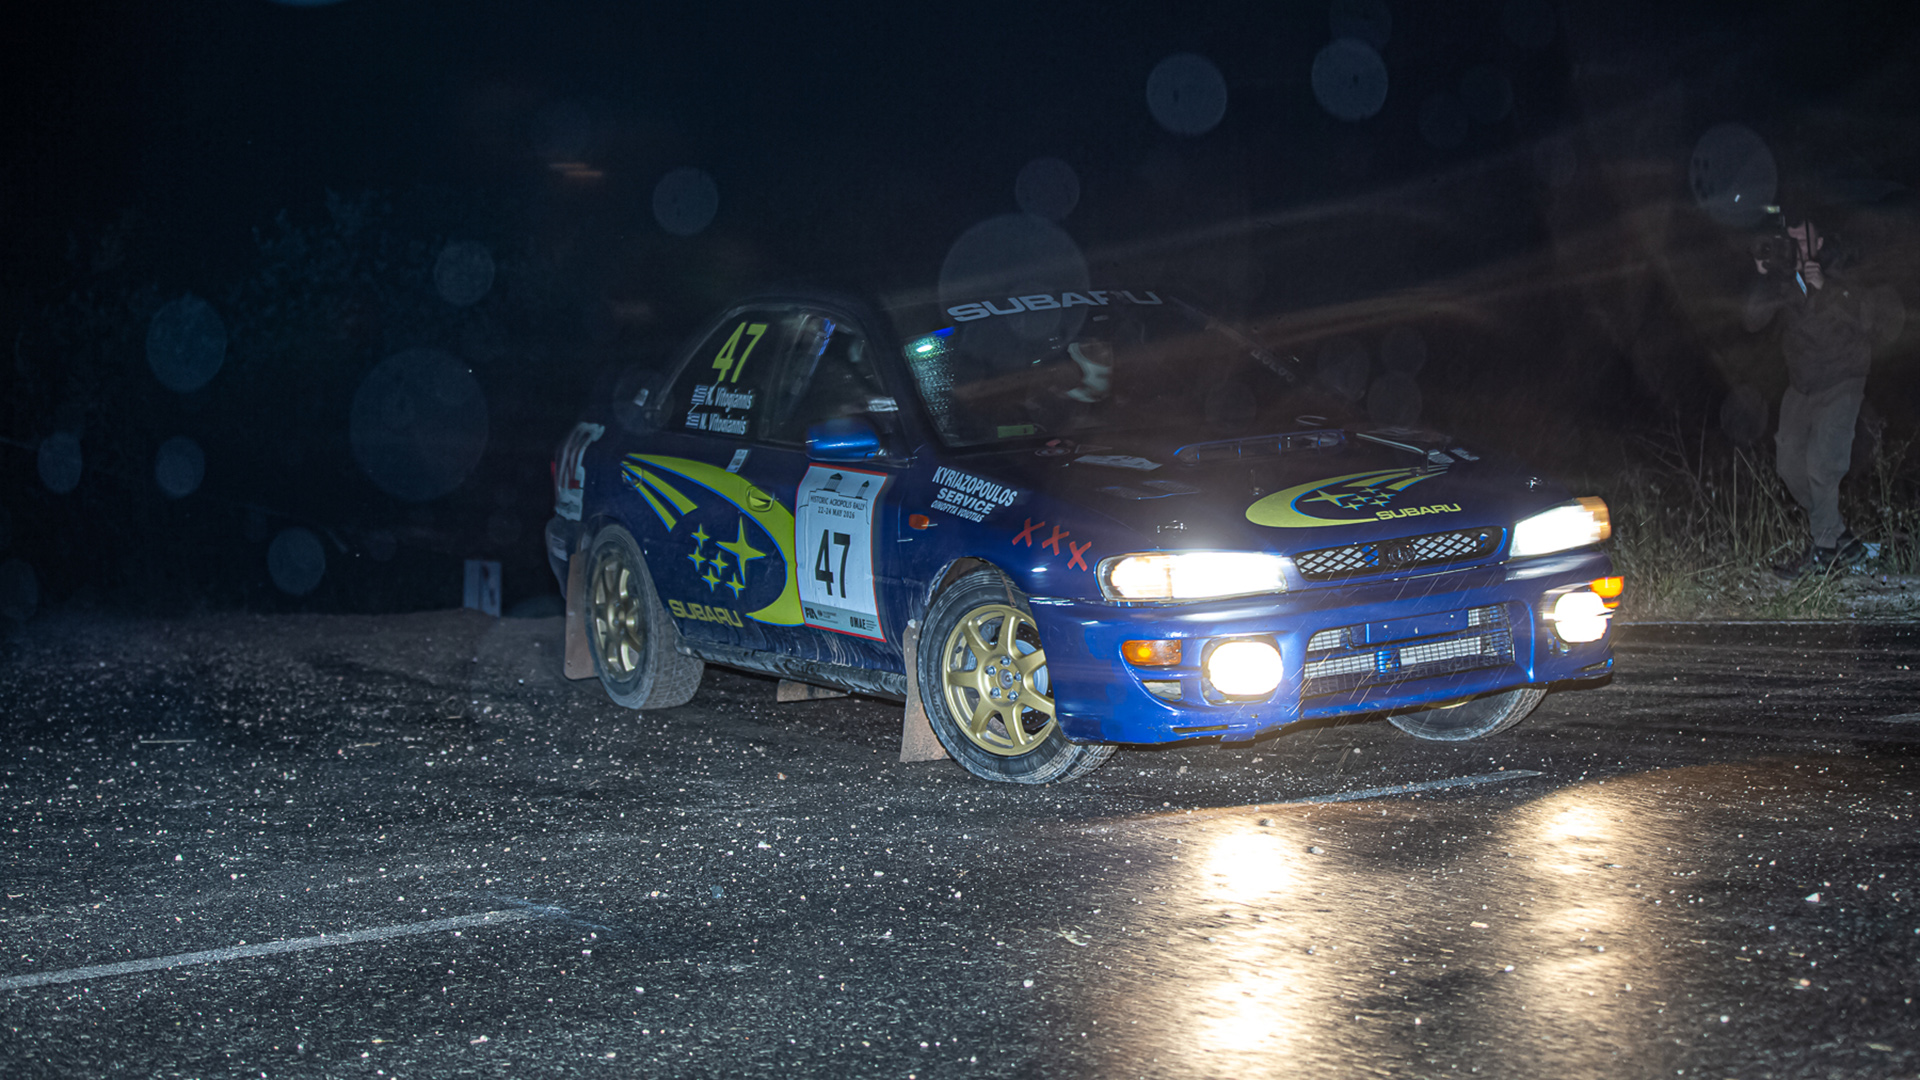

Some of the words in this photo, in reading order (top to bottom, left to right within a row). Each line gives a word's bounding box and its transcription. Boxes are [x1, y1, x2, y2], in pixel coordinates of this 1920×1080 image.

[712, 321, 768, 384] 47
[932, 466, 1018, 507] KYRIAZOPOULOS
[810, 495, 829, 505] HISTORIC
[829, 499, 852, 509] ACROPOLIS
[853, 502, 866, 510] RALLY
[817, 506, 832, 515] 22-24
[832, 508, 842, 517] MAY
[937, 487, 996, 515] SERVICE
[1375, 502, 1462, 521] SUBARU
[815, 529, 850, 598] 47
[668, 599, 744, 628] SUBARU
